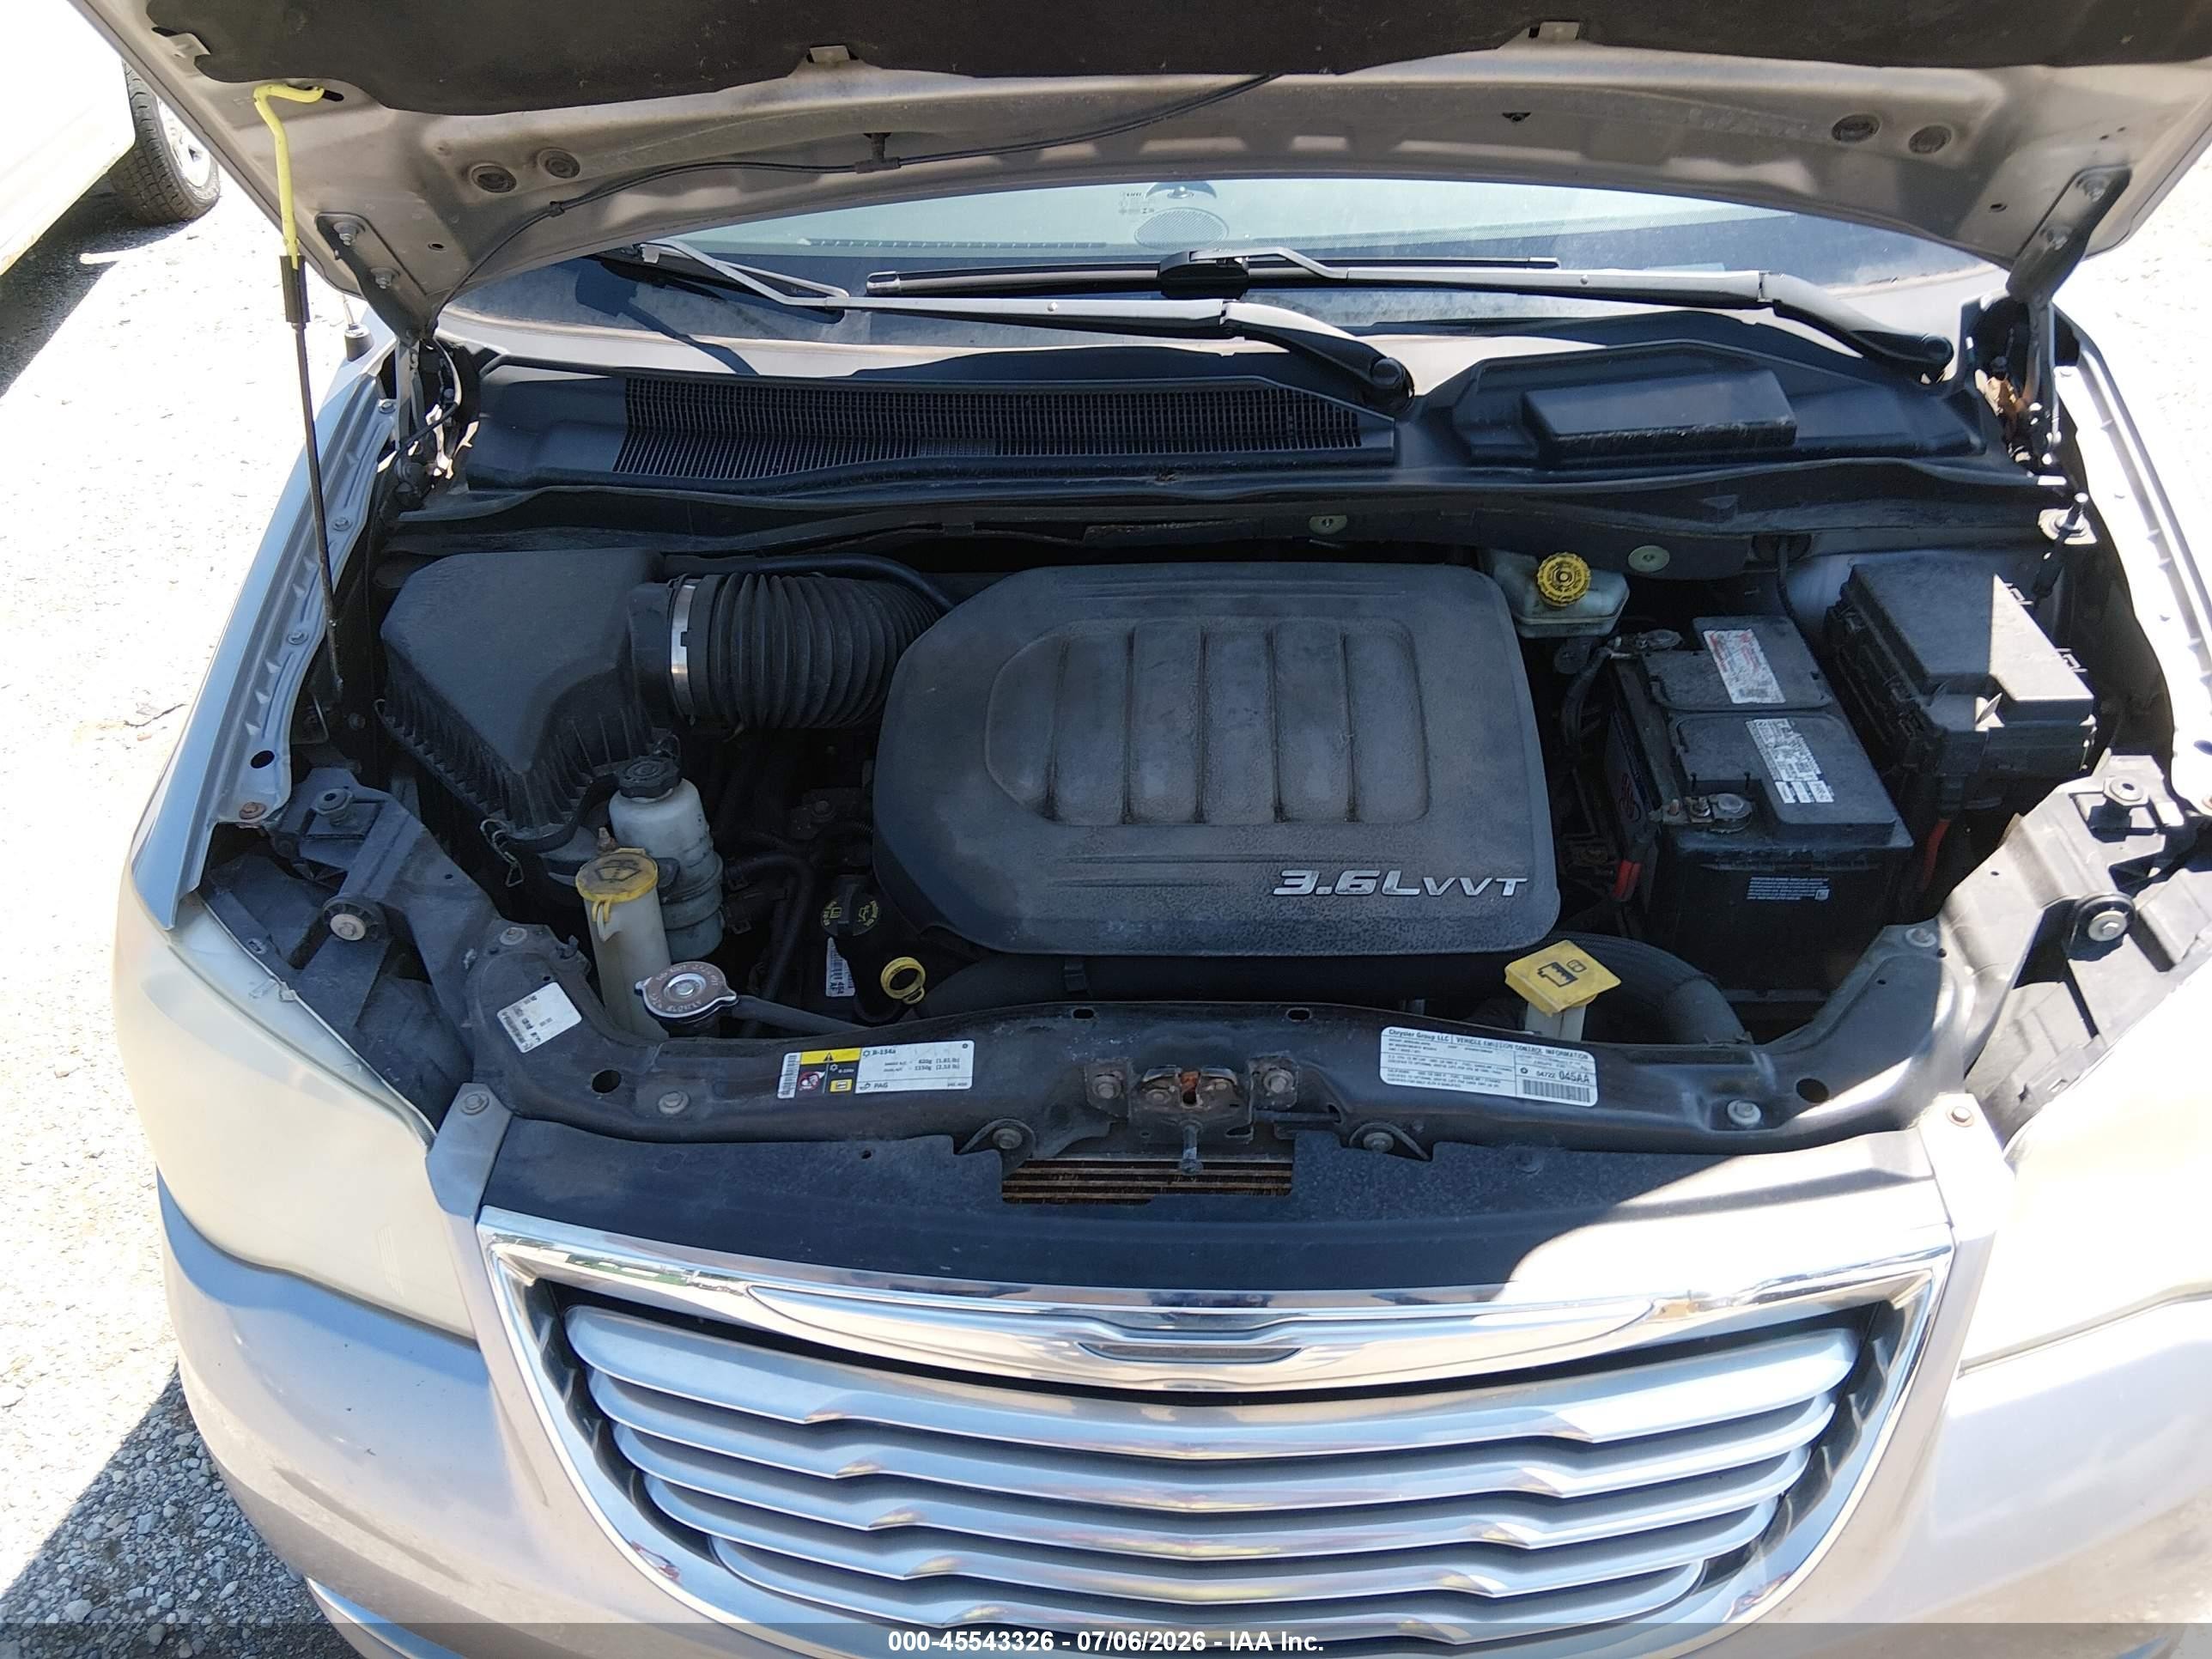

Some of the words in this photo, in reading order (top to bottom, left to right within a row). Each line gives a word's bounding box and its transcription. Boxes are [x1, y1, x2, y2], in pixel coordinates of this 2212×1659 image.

[1273, 869, 1420, 896] 3.6L
[1422, 877, 1528, 896] VVT
[1389, 1029, 1414, 1038] Chrysler
[1416, 1032, 1435, 1041] Group
[1456, 1036, 1481, 1045] VEHICLE
[1516, 1044, 1541, 1054] CONTROL
[1546, 1047, 1589, 1060] INFORMATION
